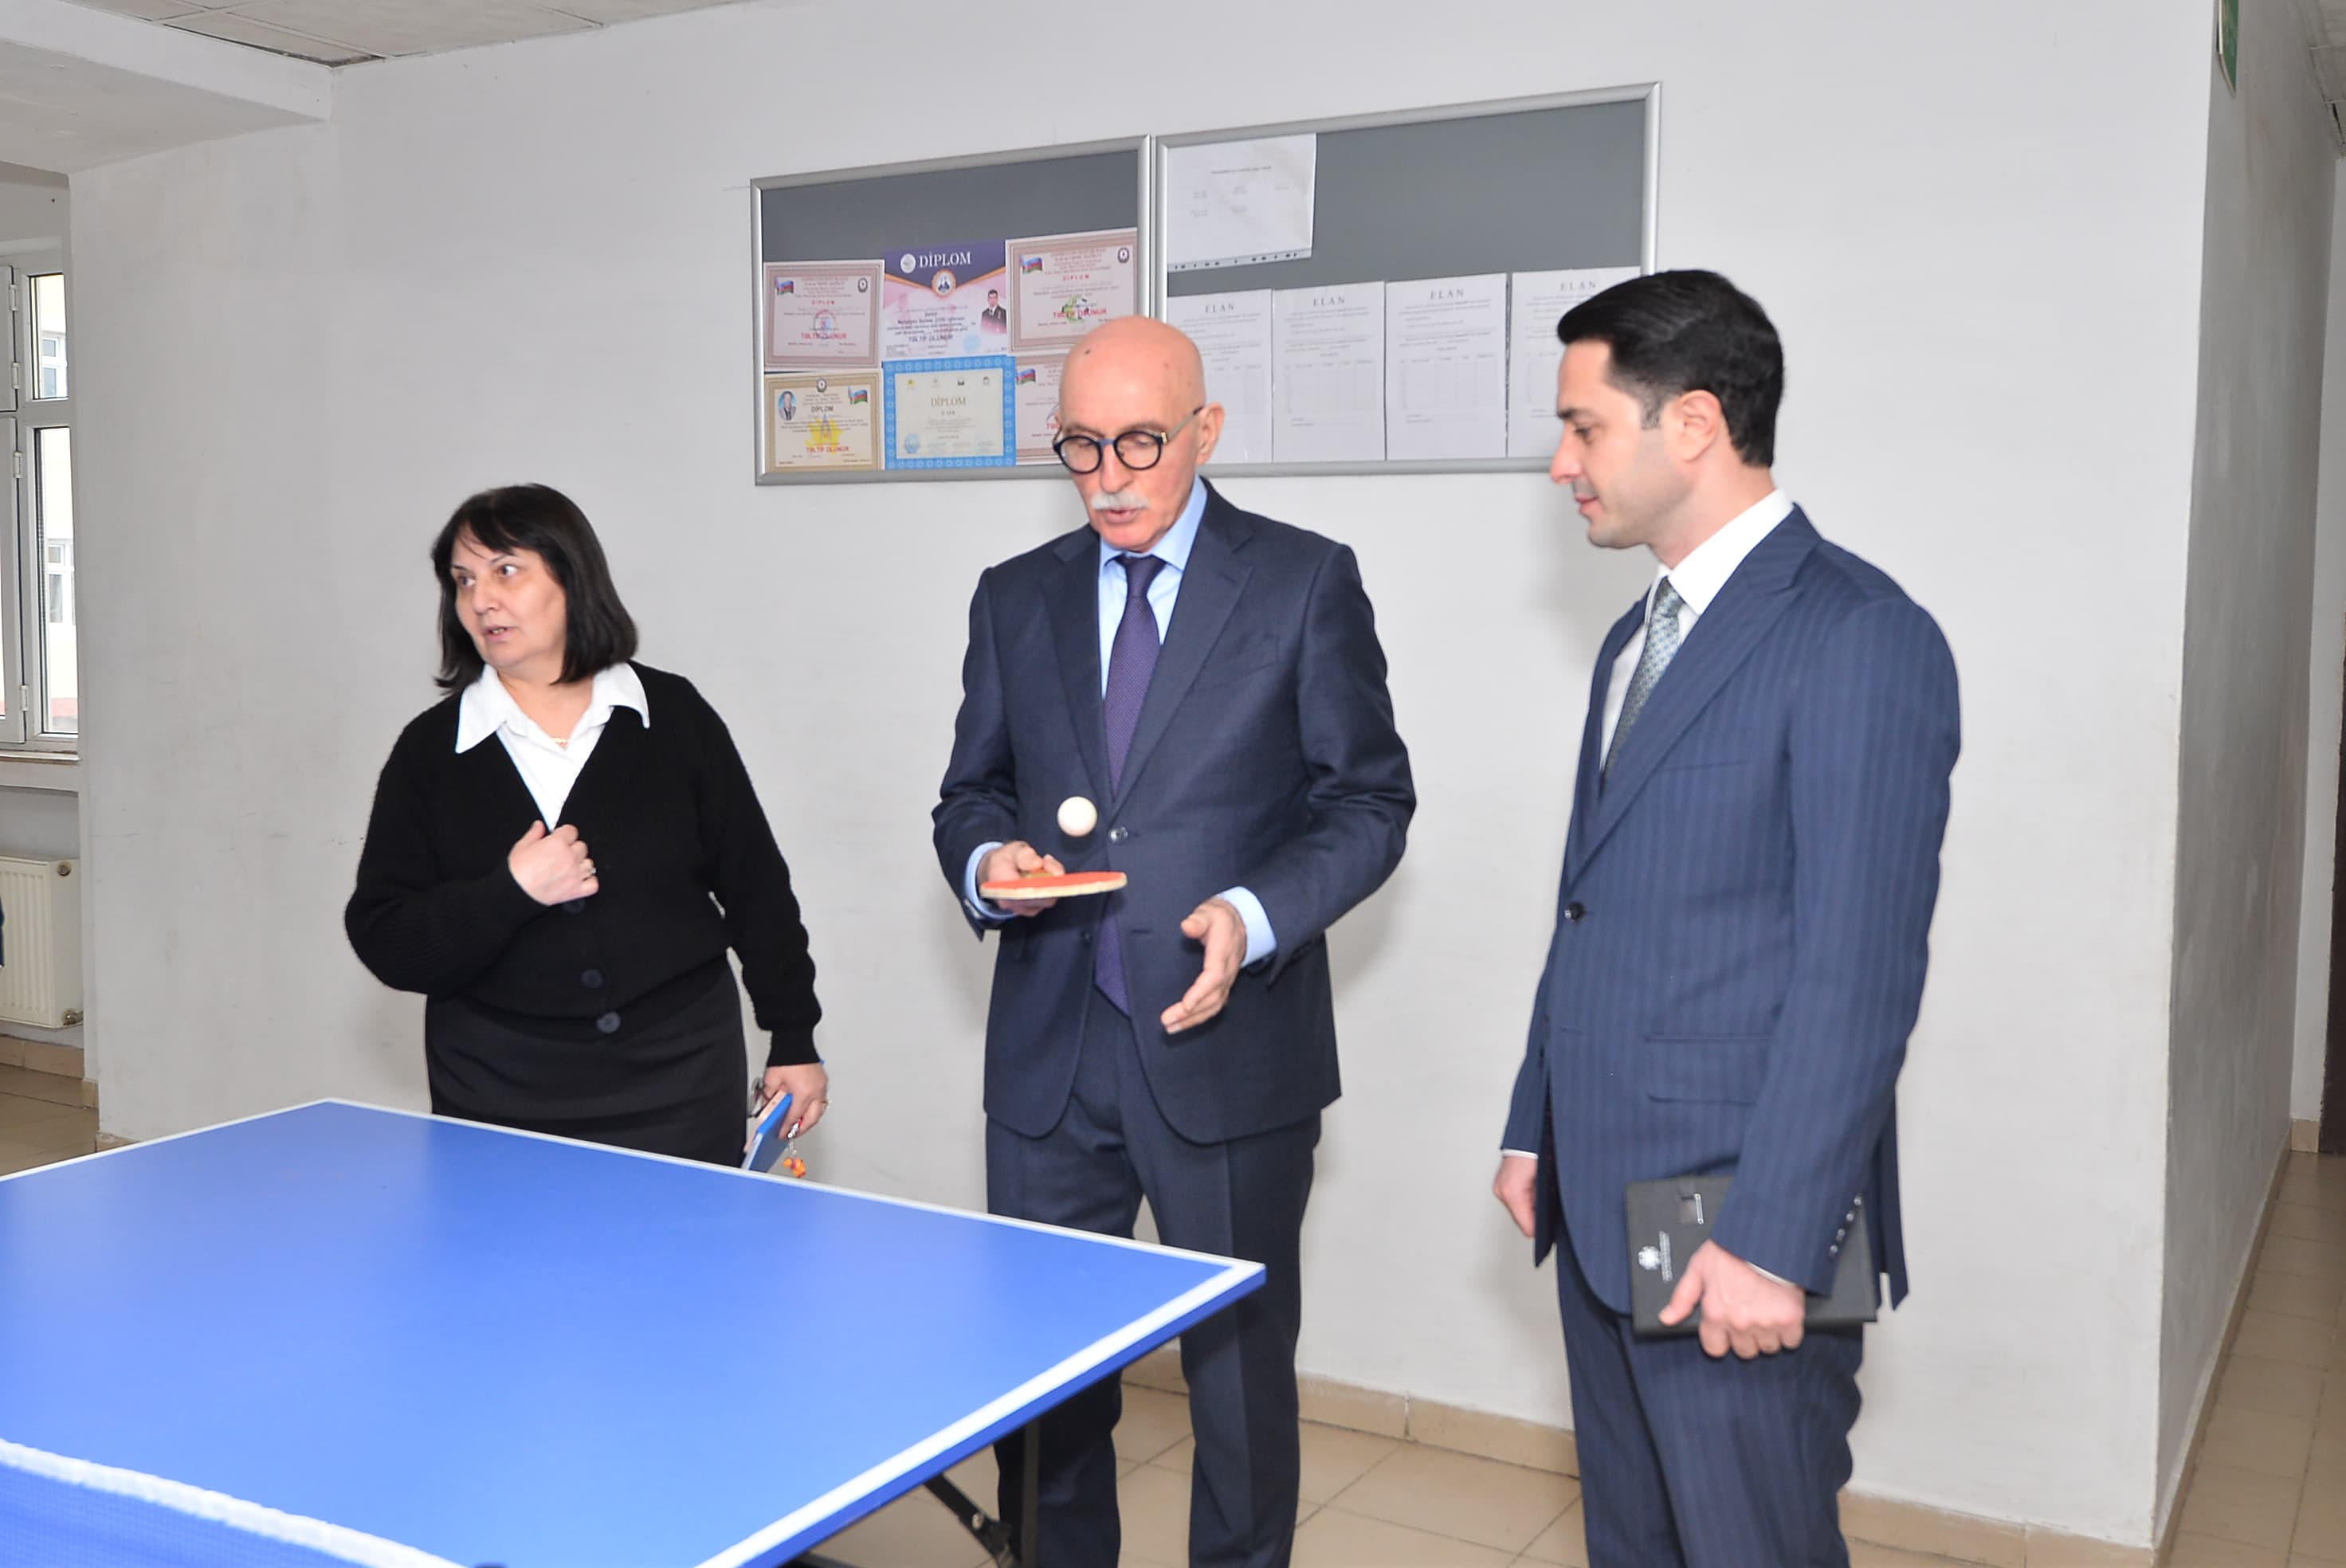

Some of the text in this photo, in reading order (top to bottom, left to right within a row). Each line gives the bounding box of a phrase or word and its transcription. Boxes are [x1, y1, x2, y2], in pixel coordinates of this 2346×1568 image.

[919, 252, 971, 269] DİPLOM
[1561, 280, 1596, 292] ELAN
[1430, 288, 1464, 300] ELAN
[1313, 296, 1345, 307] ELAN
[1205, 304, 1234, 313] ELAN
